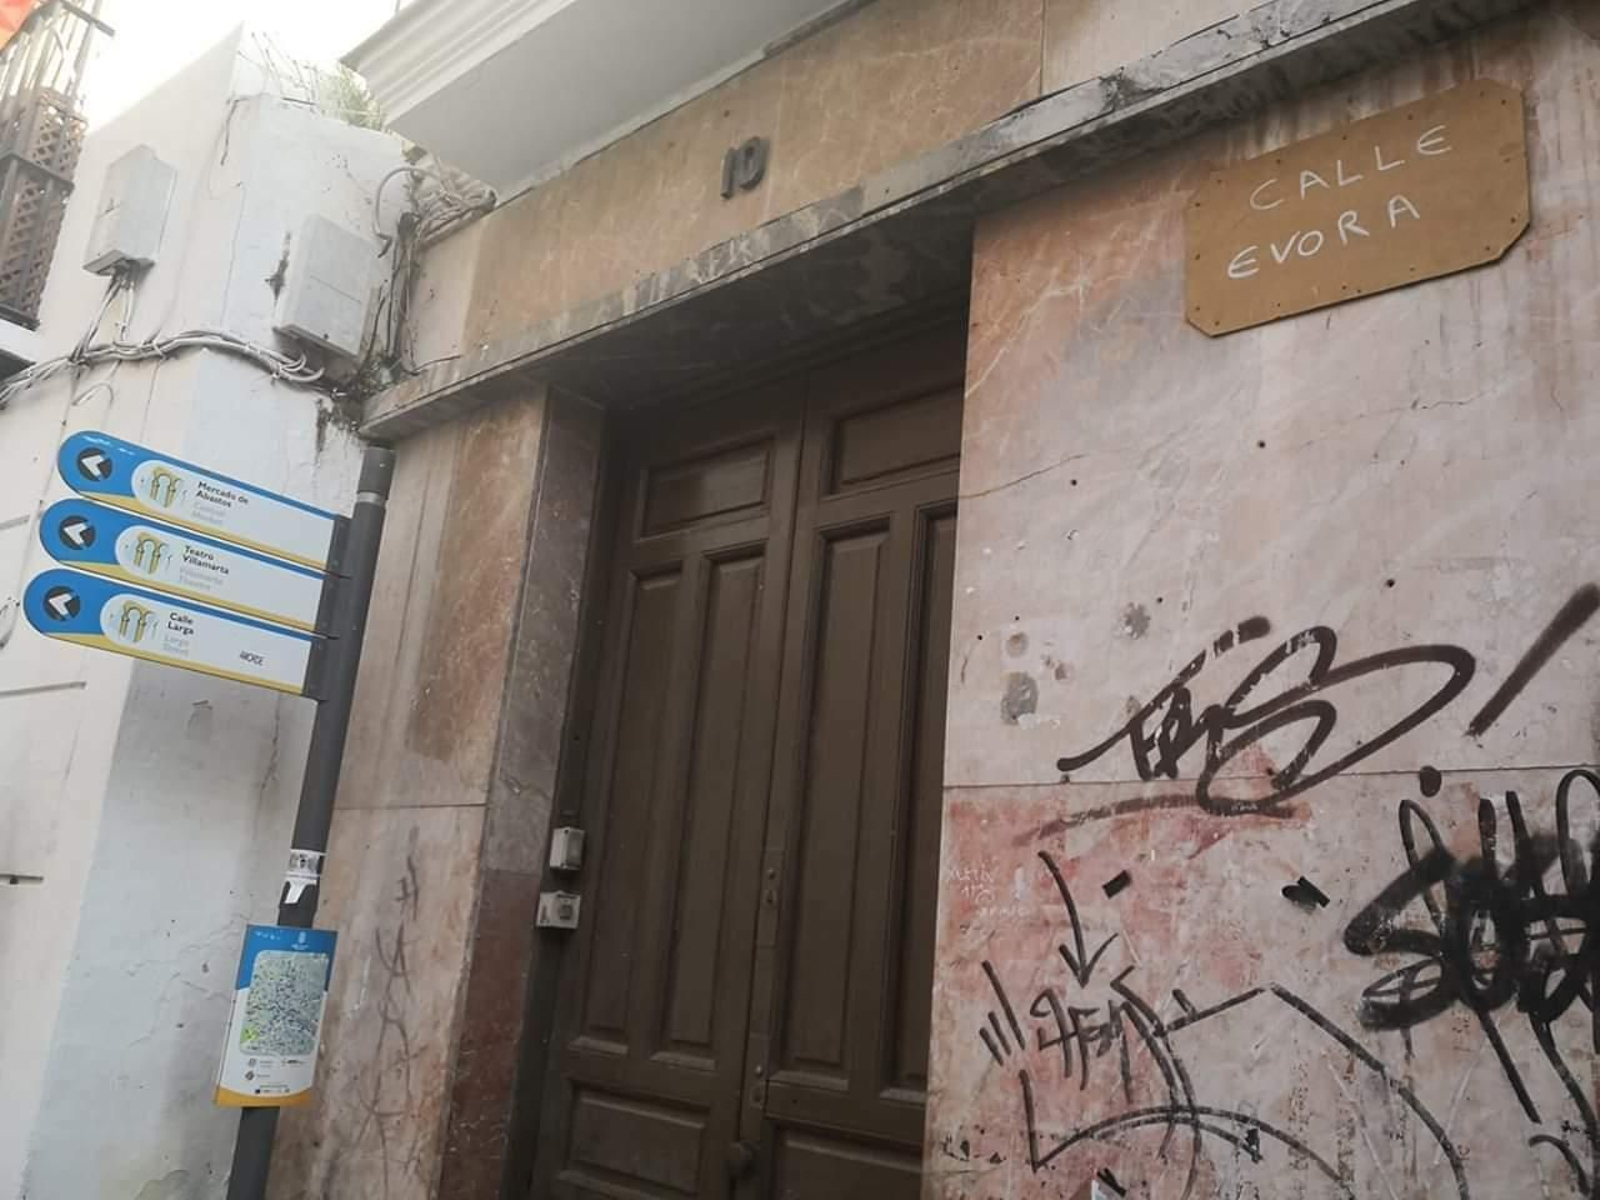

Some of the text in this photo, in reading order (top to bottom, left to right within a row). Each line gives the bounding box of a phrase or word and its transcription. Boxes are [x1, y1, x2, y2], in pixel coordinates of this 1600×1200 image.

[1249, 124, 1451, 211] CALLE
[1227, 194, 1420, 279] EVORA
[195, 489, 232, 508] Abastos
[198, 480, 237, 501] Mercado
[184, 545, 215, 561] Teatro
[182, 553, 229, 575] Villamarta
[167, 620, 194, 636] Larga
[169, 612, 194, 625] Calle
